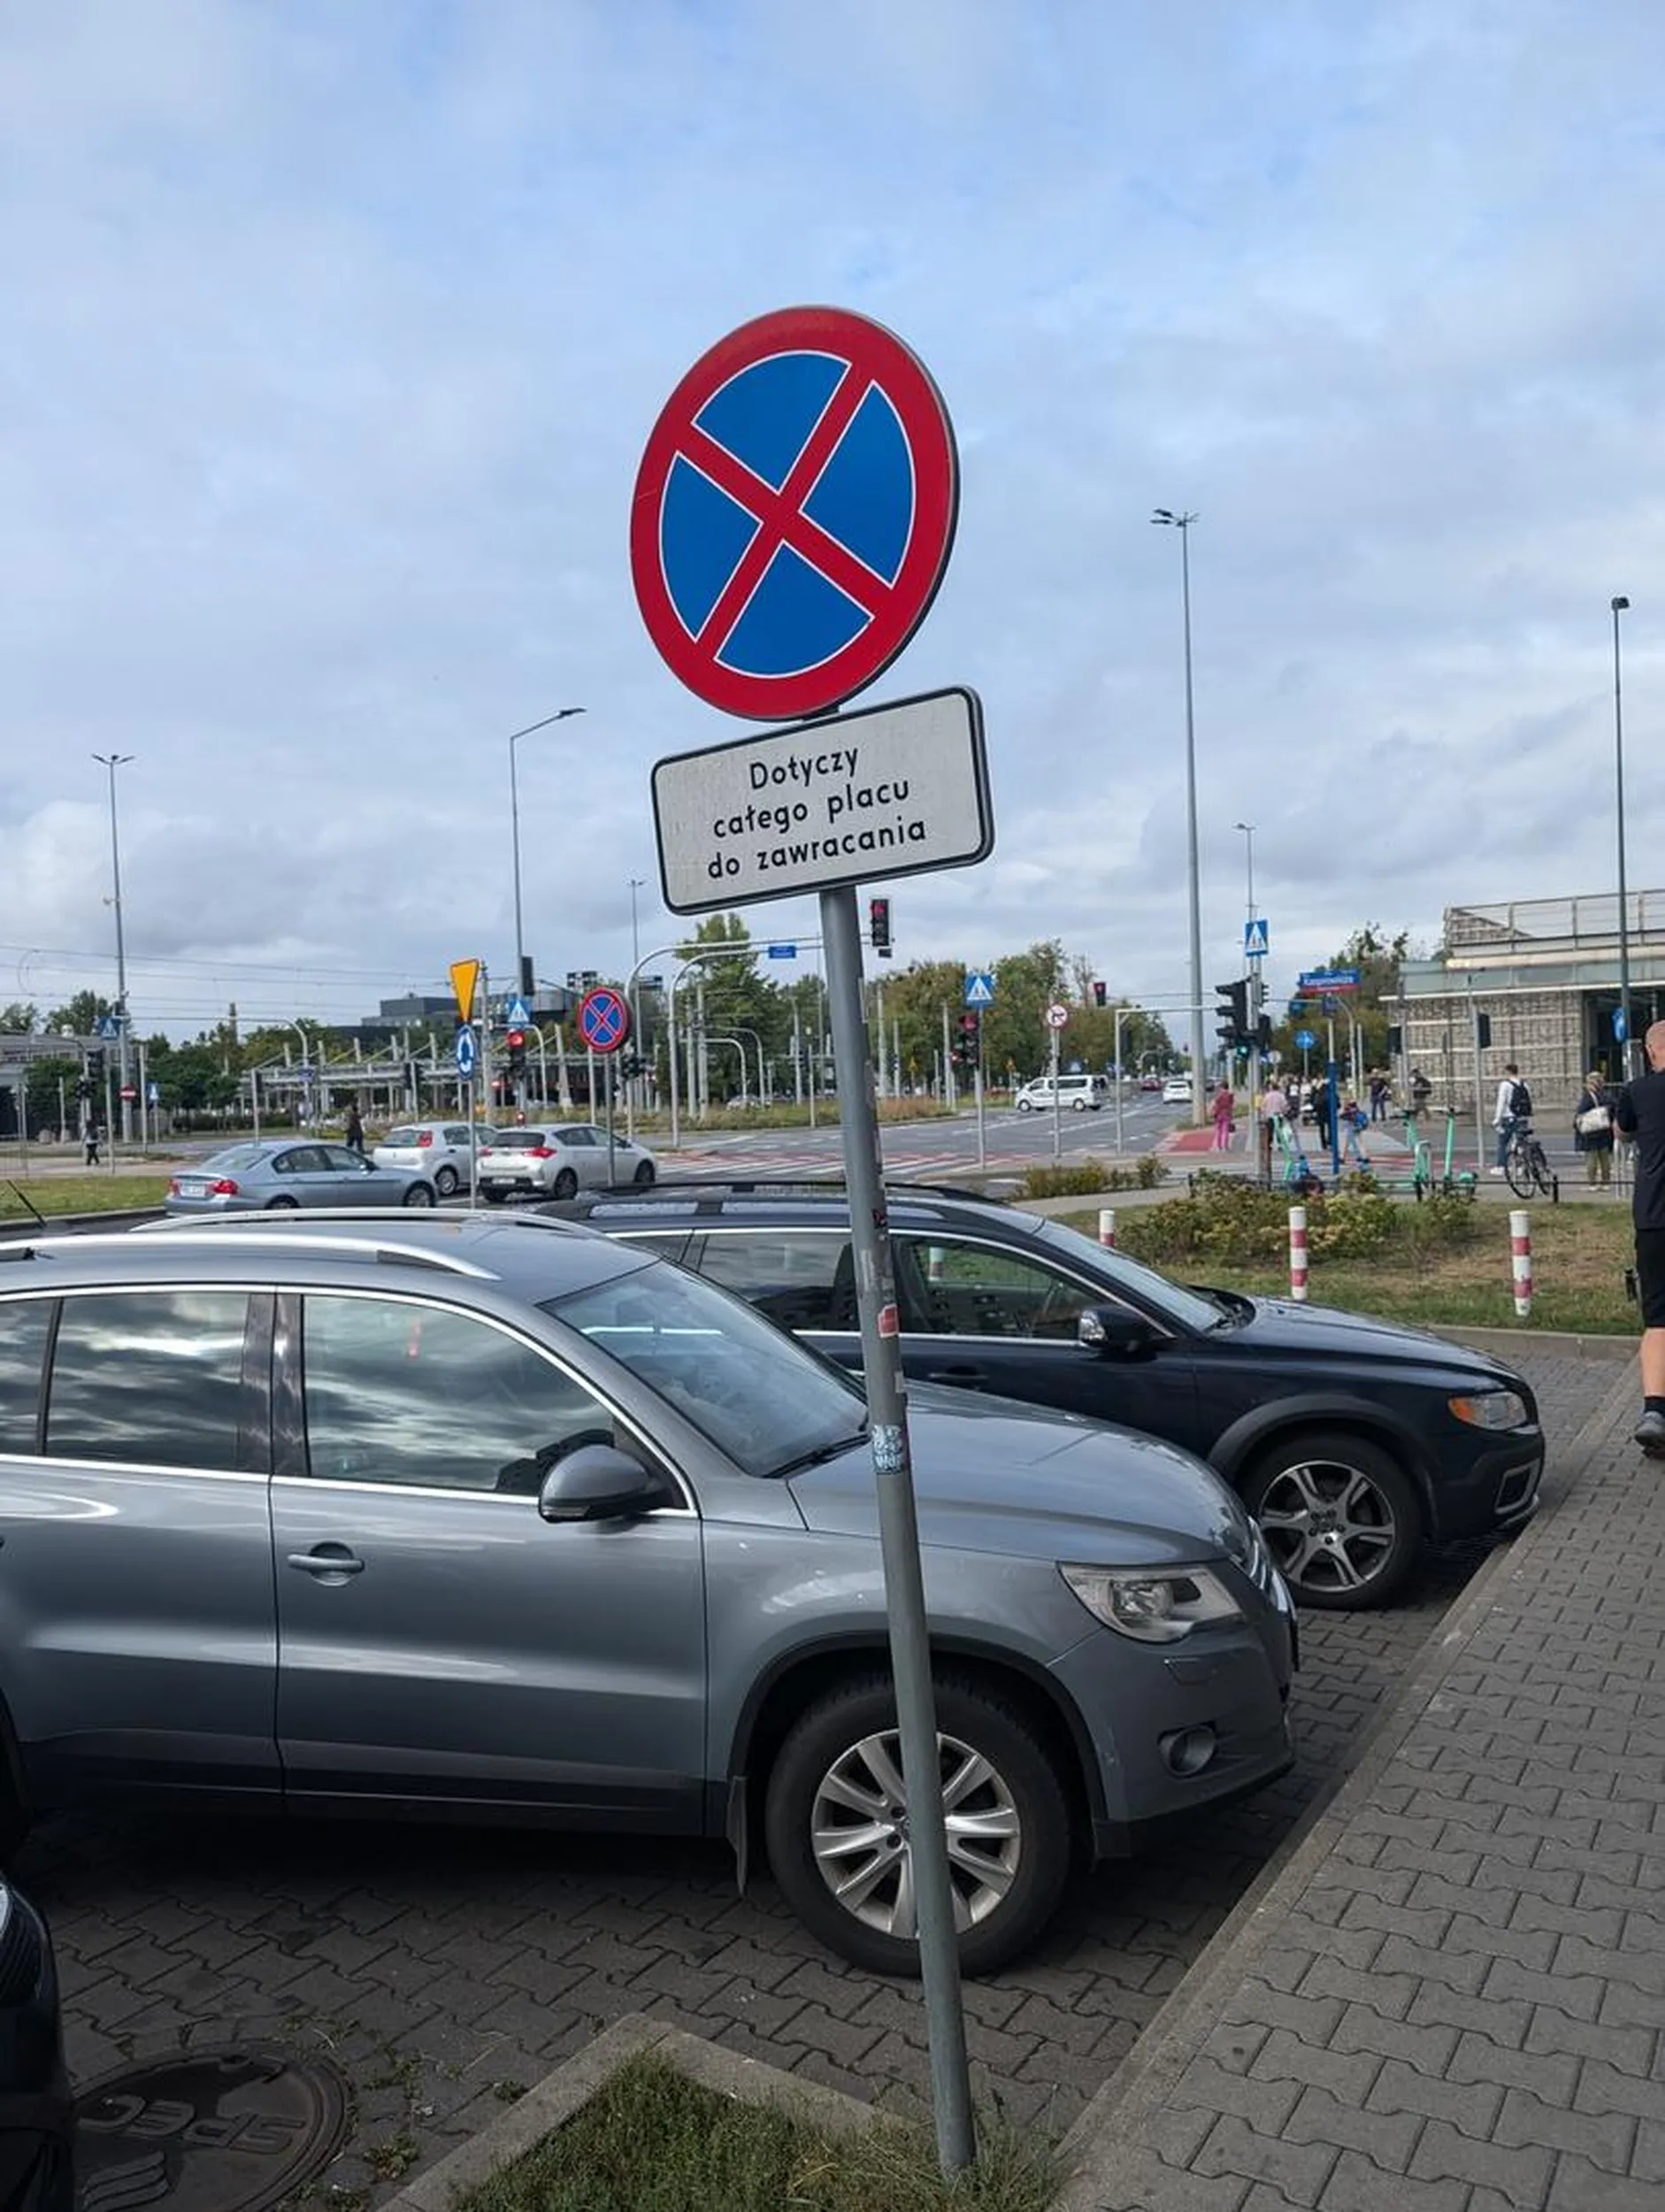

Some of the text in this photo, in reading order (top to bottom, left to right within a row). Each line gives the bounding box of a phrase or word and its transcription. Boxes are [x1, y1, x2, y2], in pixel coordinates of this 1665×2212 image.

[749, 748, 859, 790] Dotyczy
[713, 780, 909, 839] całego placu
[707, 815, 926, 879] do zawracania
